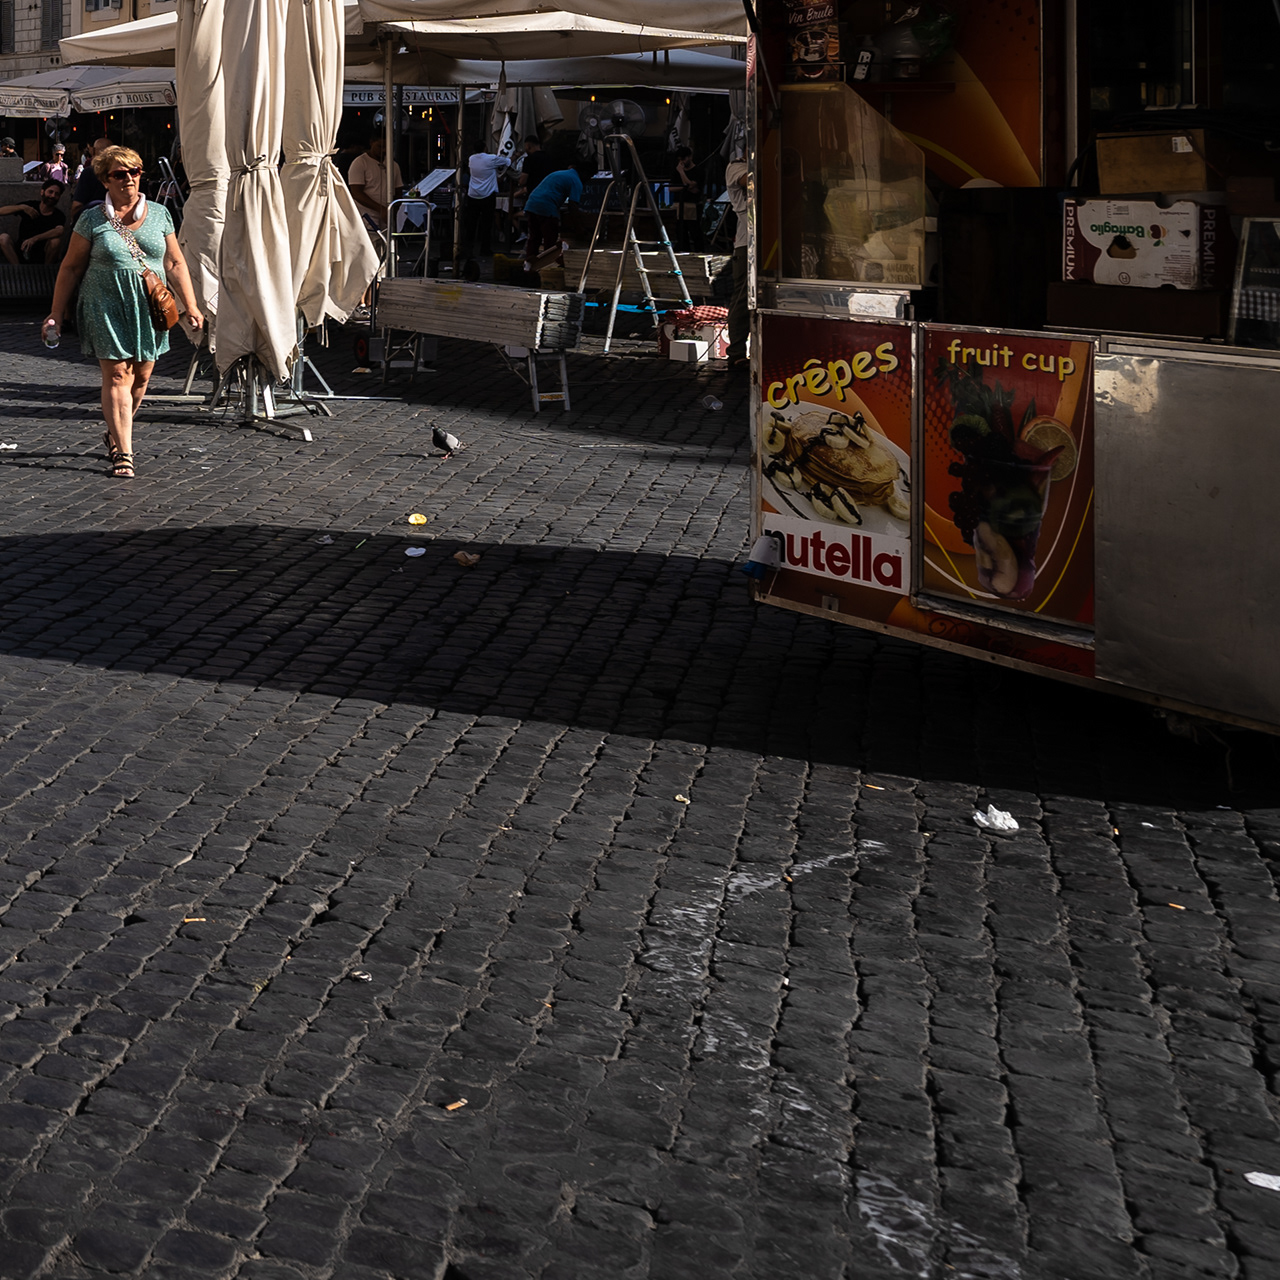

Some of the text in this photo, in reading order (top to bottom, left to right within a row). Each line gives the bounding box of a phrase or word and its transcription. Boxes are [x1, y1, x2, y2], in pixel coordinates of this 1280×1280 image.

[788, 12, 804, 24] Vin
[126, 93, 155, 103] HOUSE
[351, 92, 374, 102] PUB
[1065, 206, 1076, 281] PREMIUM
[1090, 222, 1145, 238] Battaglio
[1203, 209, 1217, 288] PREMIUM
[947, 338, 1077, 382] fruit cup
[766, 340, 900, 411] crêpes
